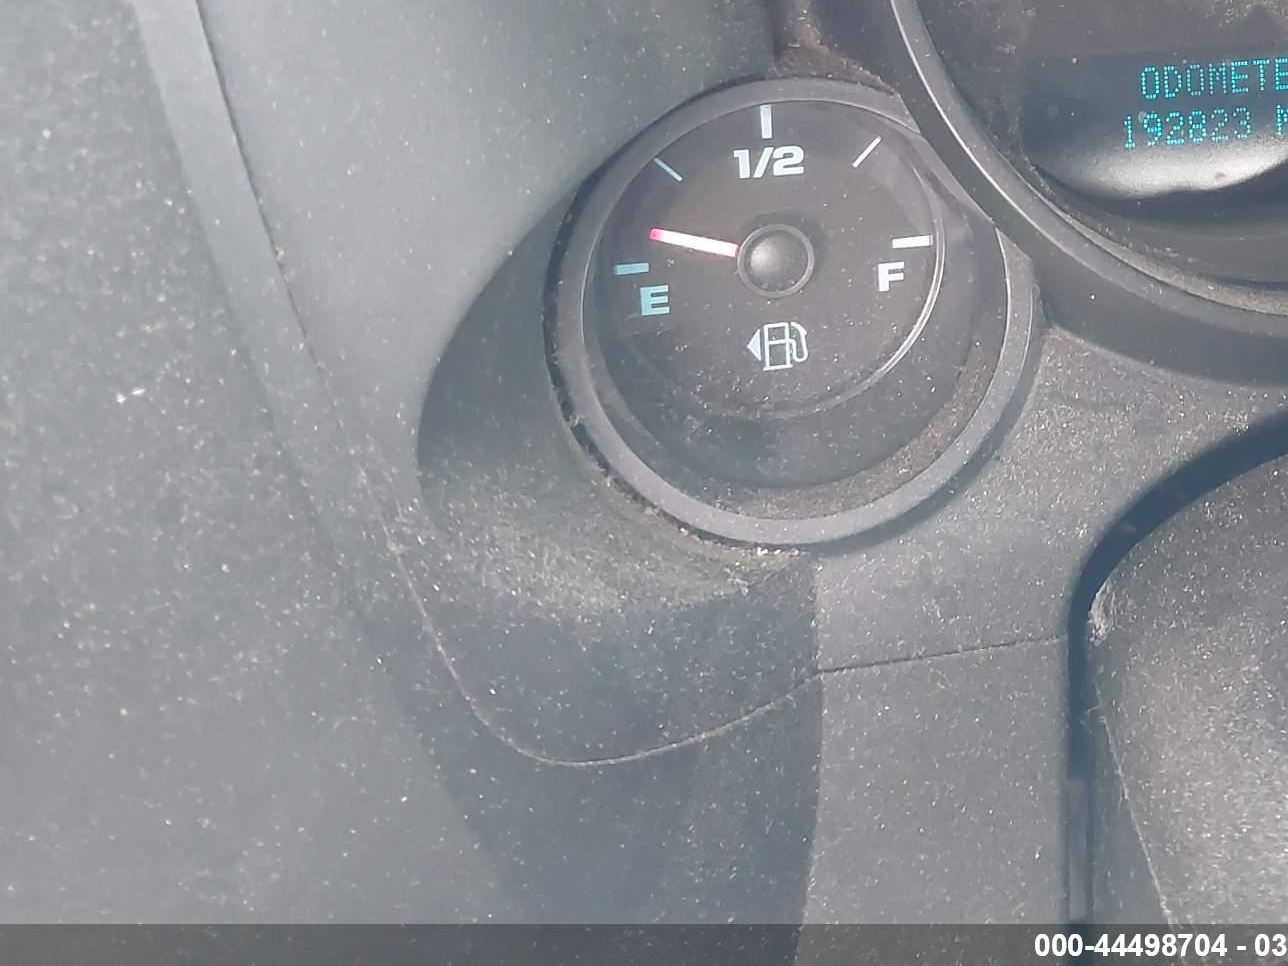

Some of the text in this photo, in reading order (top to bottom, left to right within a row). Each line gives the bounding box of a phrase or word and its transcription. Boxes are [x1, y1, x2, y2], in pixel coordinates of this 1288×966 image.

[1124, 107, 1251, 149] 192823
[733, 145, 805, 179] 1/2
[877, 261, 905, 292] F
[640, 284, 670, 316] E
